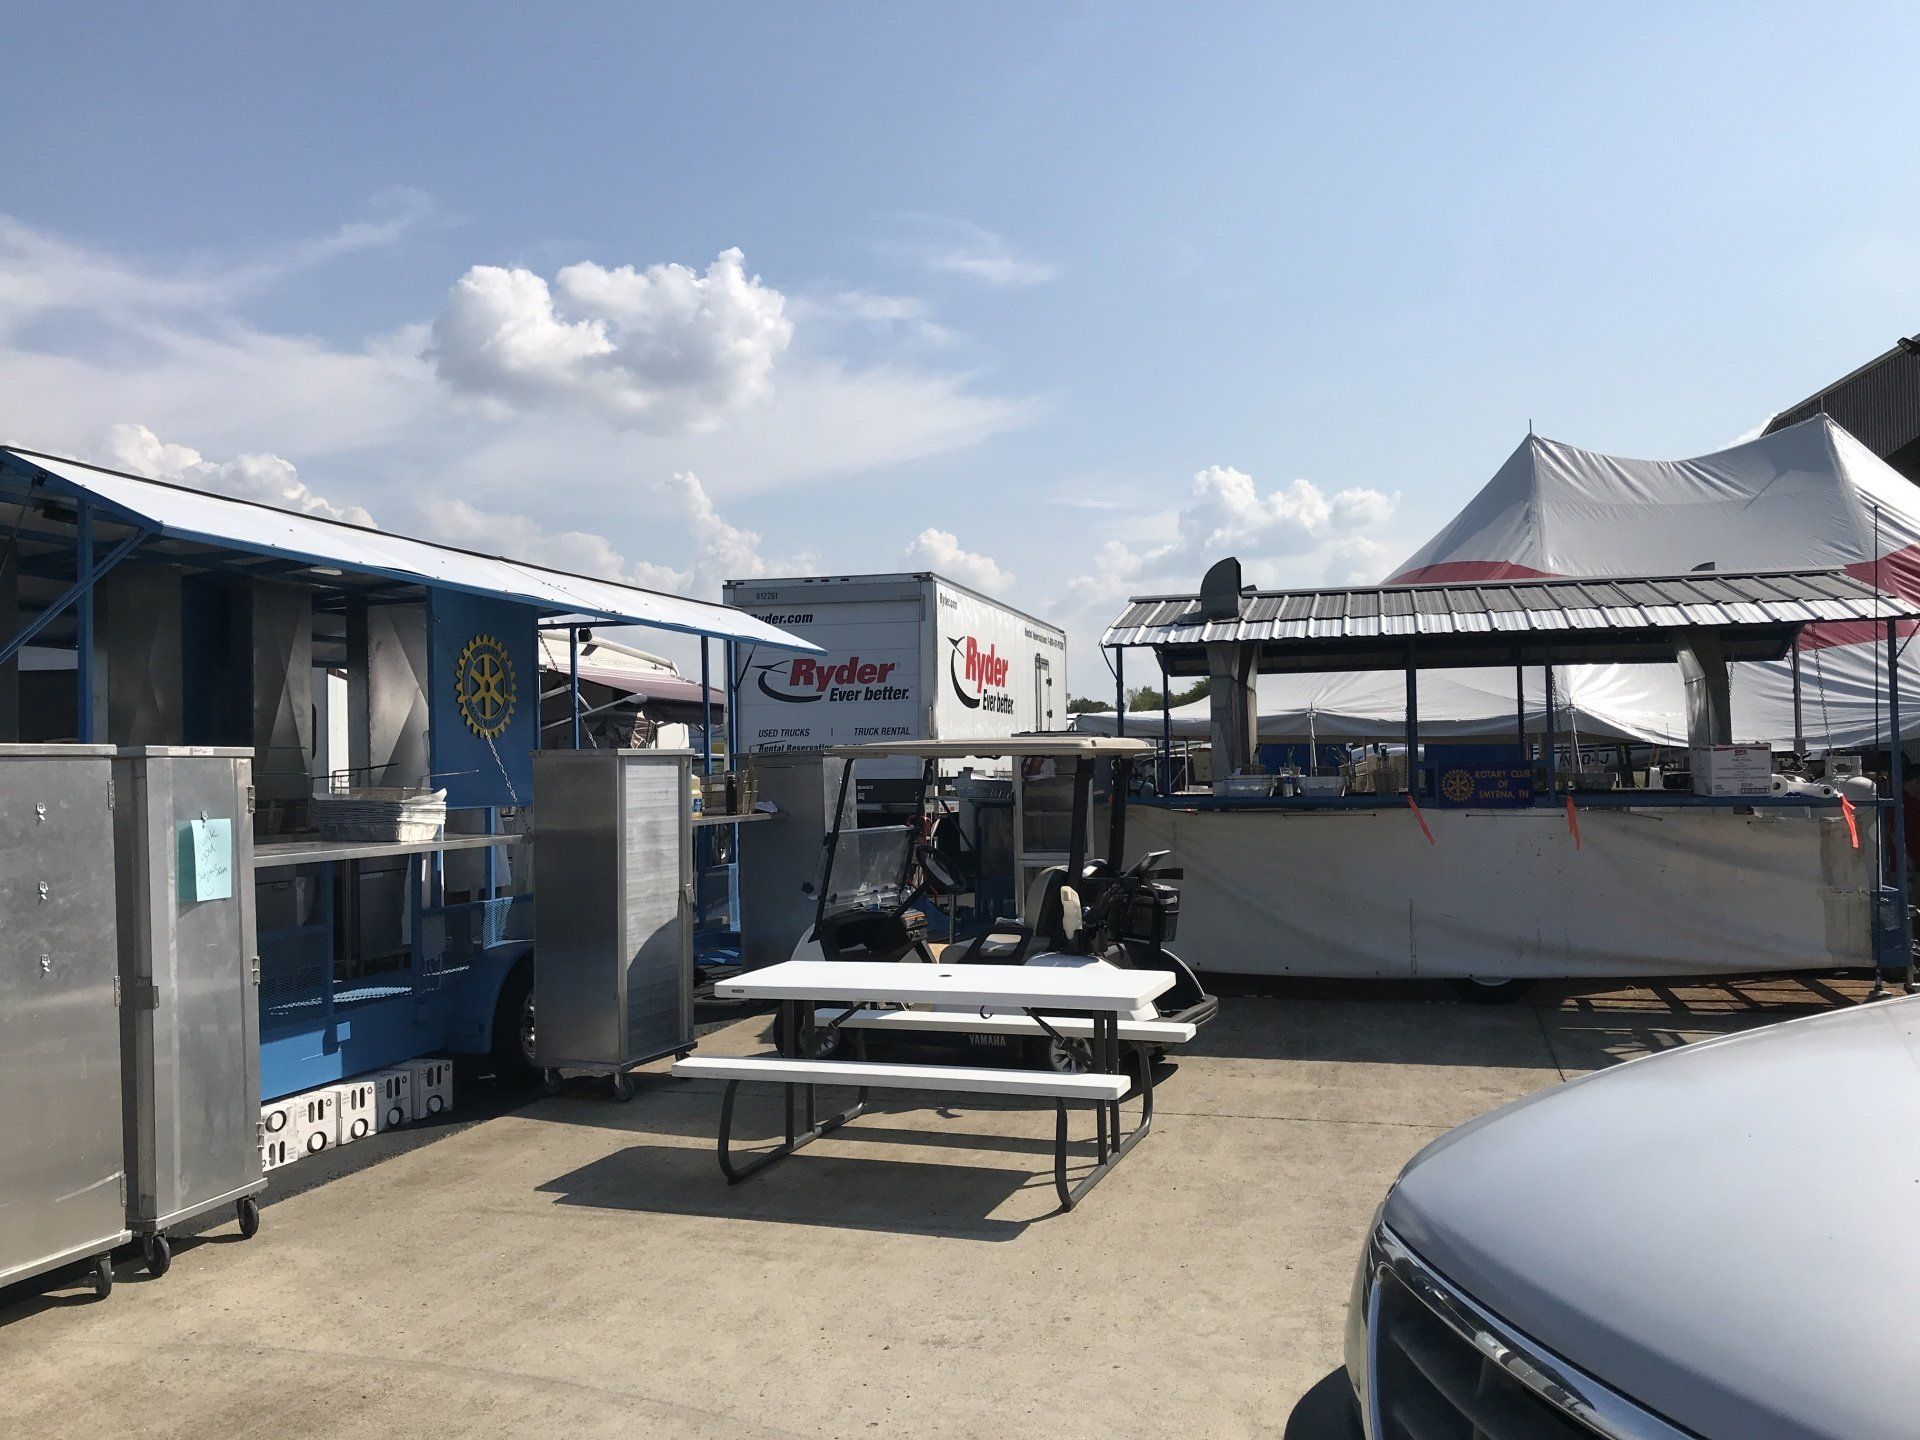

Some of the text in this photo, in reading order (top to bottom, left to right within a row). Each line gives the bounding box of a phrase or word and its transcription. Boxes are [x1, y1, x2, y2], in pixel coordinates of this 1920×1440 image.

[966, 636, 1008, 693] Ryder
[789, 657, 895, 692] Ryder
[829, 686, 909, 701] Ever better.
[983, 689, 995, 711] Ever
[758, 727, 910, 737] USED TRUCKS TRUCK RENTAL
[758, 743, 833, 752] Rental Reservation
[1475, 769, 1531, 778] ROTARY CLUB
[1497, 780, 1508, 788] OF
[1519, 790, 1529, 798] TN
[969, 1034, 1006, 1046] YAMAHA
